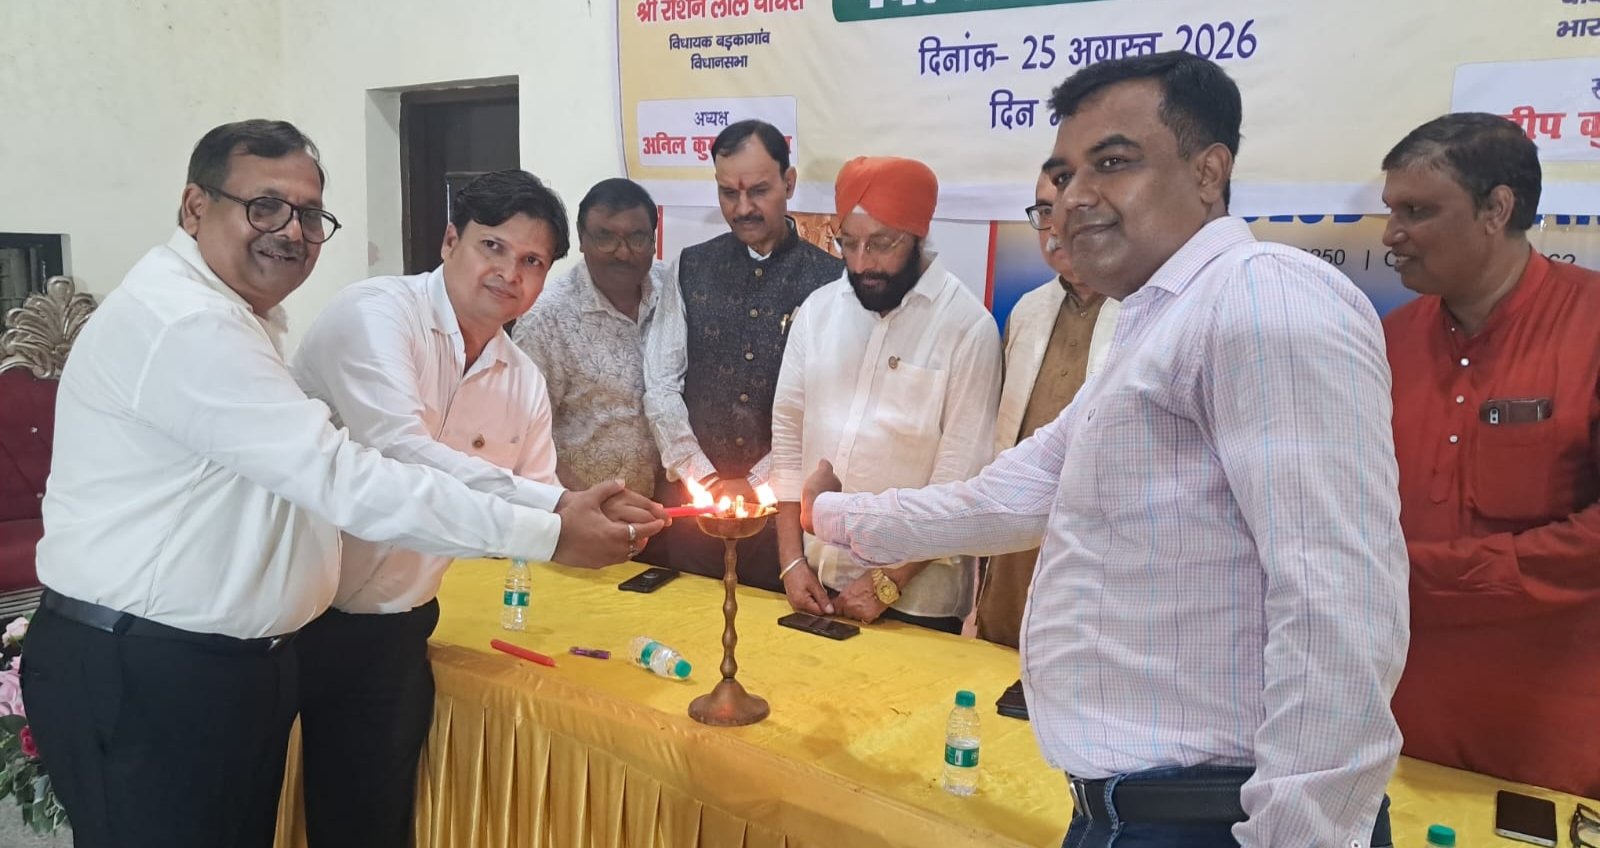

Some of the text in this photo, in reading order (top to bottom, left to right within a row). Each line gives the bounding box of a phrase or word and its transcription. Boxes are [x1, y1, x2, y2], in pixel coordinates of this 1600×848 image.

[668, 33, 713, 50] विधायक
[1021, 34, 1056, 70] 25
[1175, 19, 1258, 61] 2026
[690, 53, 748, 70] विधानसभा
[989, 89, 1039, 130] दिन
[642, 131, 686, 154] अनिल
